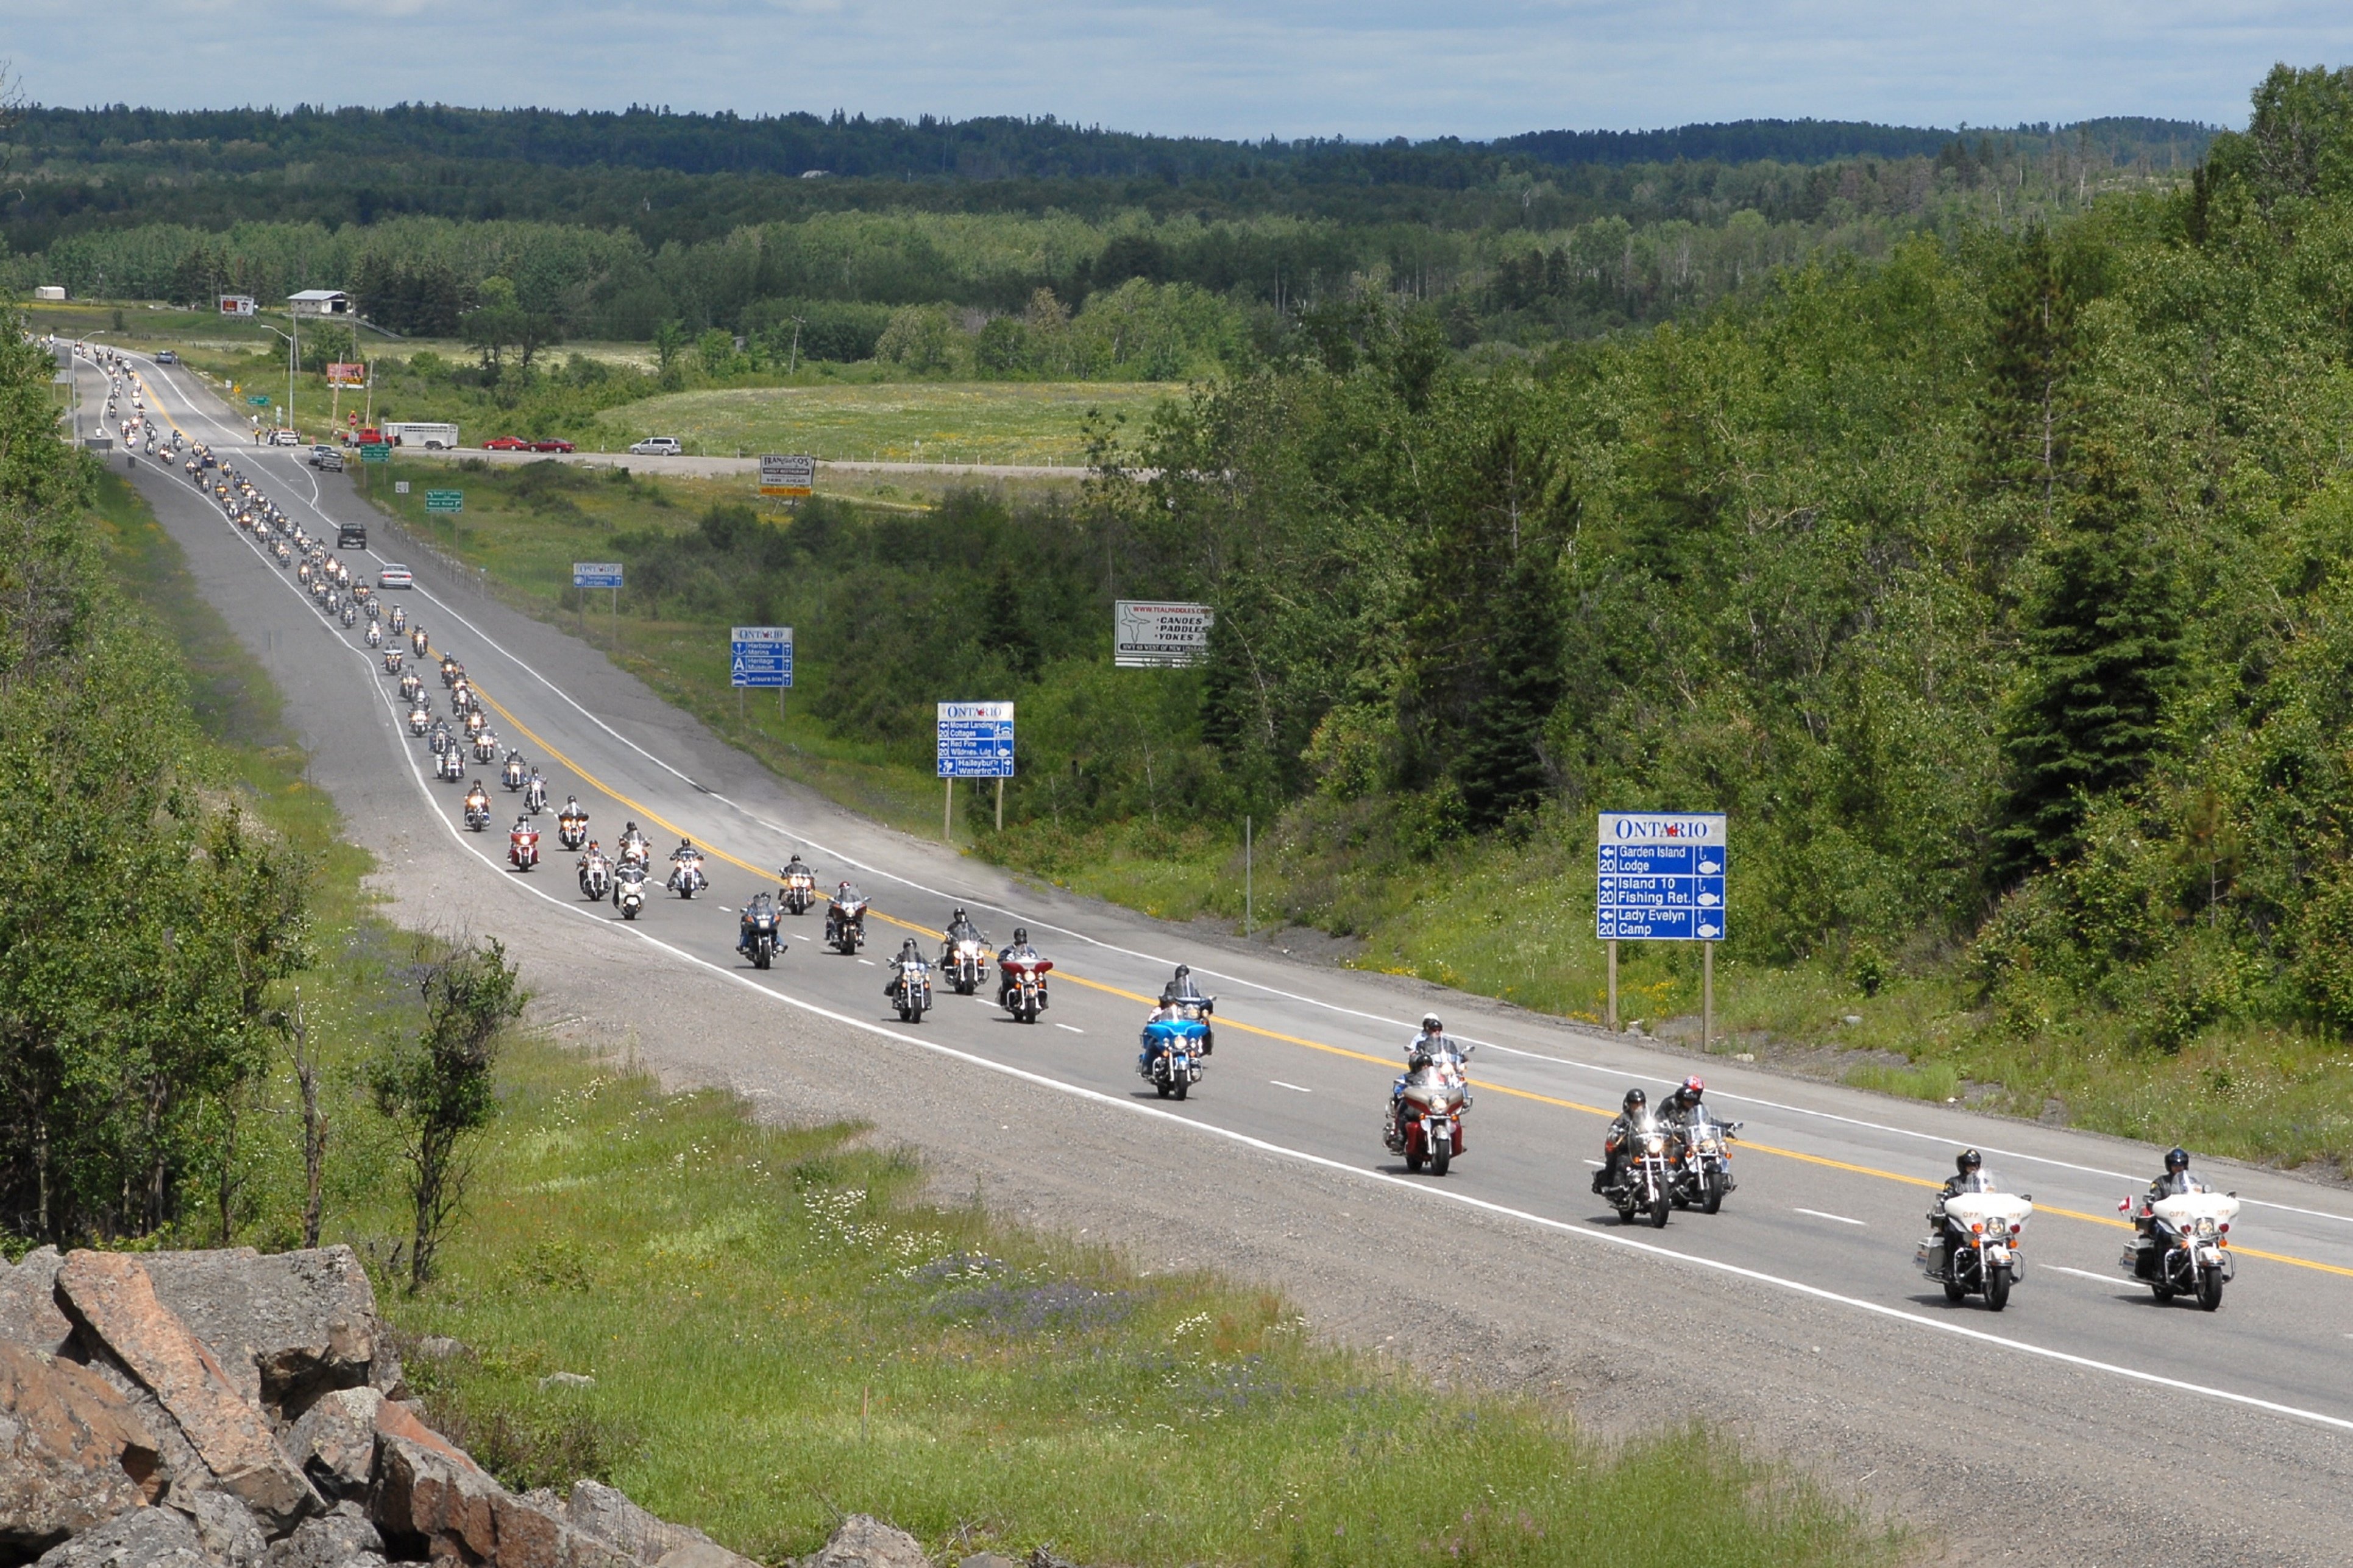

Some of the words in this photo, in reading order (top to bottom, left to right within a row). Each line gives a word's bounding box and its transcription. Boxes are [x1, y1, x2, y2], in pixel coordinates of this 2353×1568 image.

[1160, 617, 1203, 625] CANOES
[1616, 818, 1708, 840] ONTARIO
[1620, 846, 1655, 858] Garden
[1657, 846, 1686, 859] Island
[1600, 859, 1614, 872] 20
[1619, 859, 1650, 873] Lodge
[1618, 878, 1656, 889] Island
[1661, 878, 1676, 889] 10
[1600, 891, 1614, 903] 20
[1618, 891, 1664, 906] Fishing
[1667, 892, 1692, 904] Ret.
[1618, 909, 1645, 923] Lady
[1649, 909, 1686, 923] Evelyn
[1599, 923, 1614, 935] 20
[1619, 923, 1652, 937] Camp
